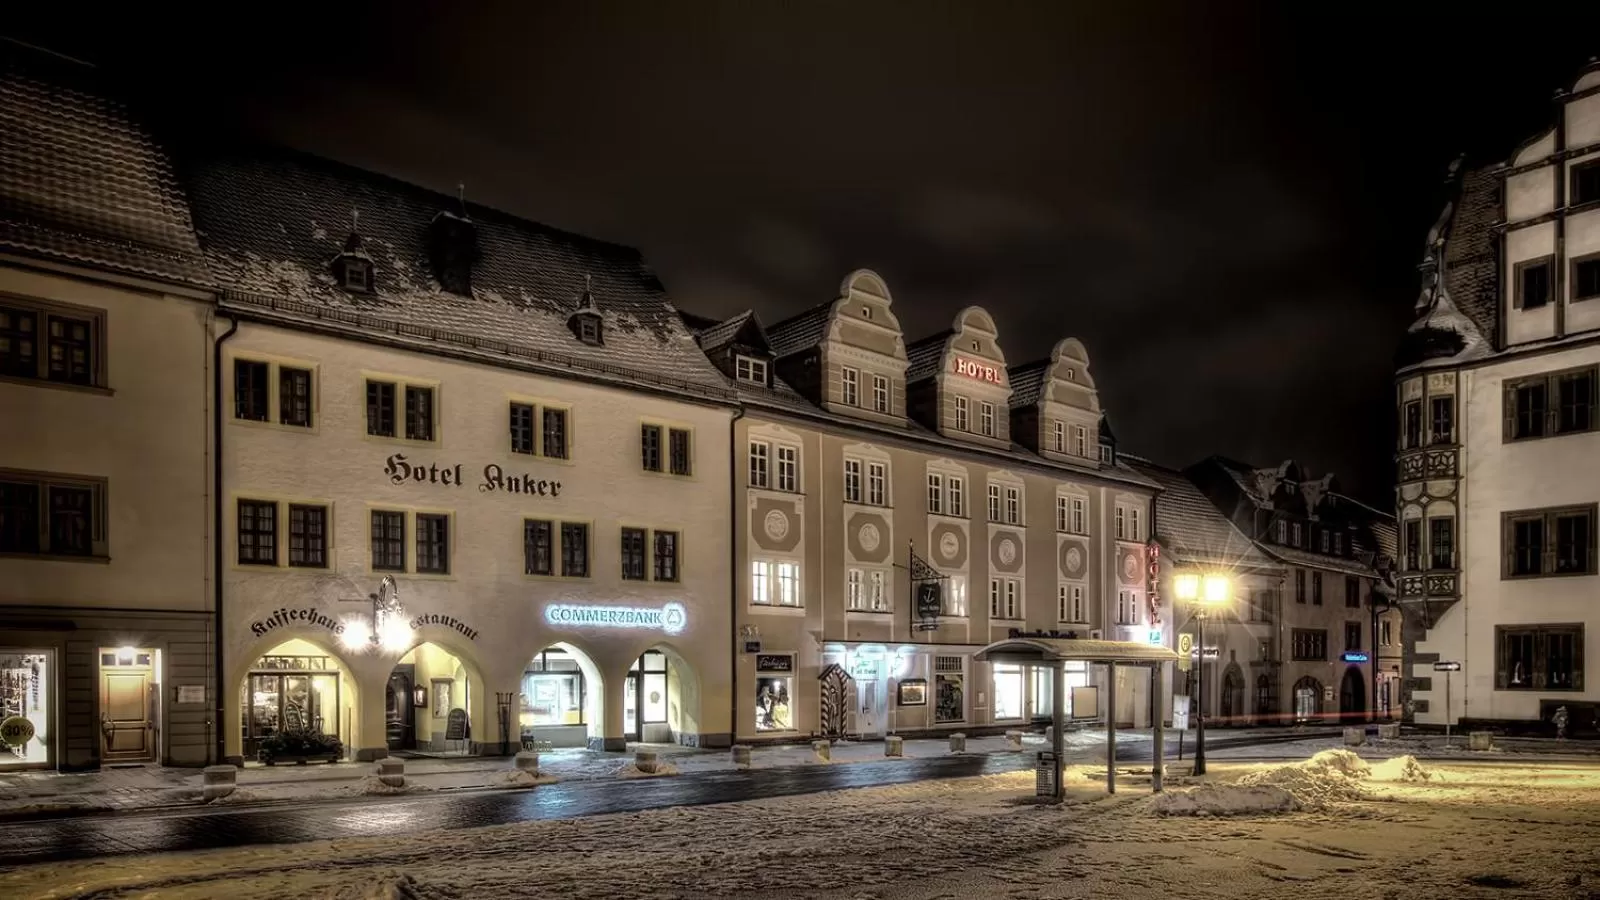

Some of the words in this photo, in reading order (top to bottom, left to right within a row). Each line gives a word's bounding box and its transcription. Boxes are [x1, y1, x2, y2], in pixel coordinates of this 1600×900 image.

[956, 358, 1001, 384] HOTEL
[384, 453, 464, 486] Hotel
[478, 464, 562, 497] Anker
[251, 607, 345, 637] Kaffeehaus
[409, 612, 480, 641] estaurant
[550, 608, 663, 624] COMMERZBANK
